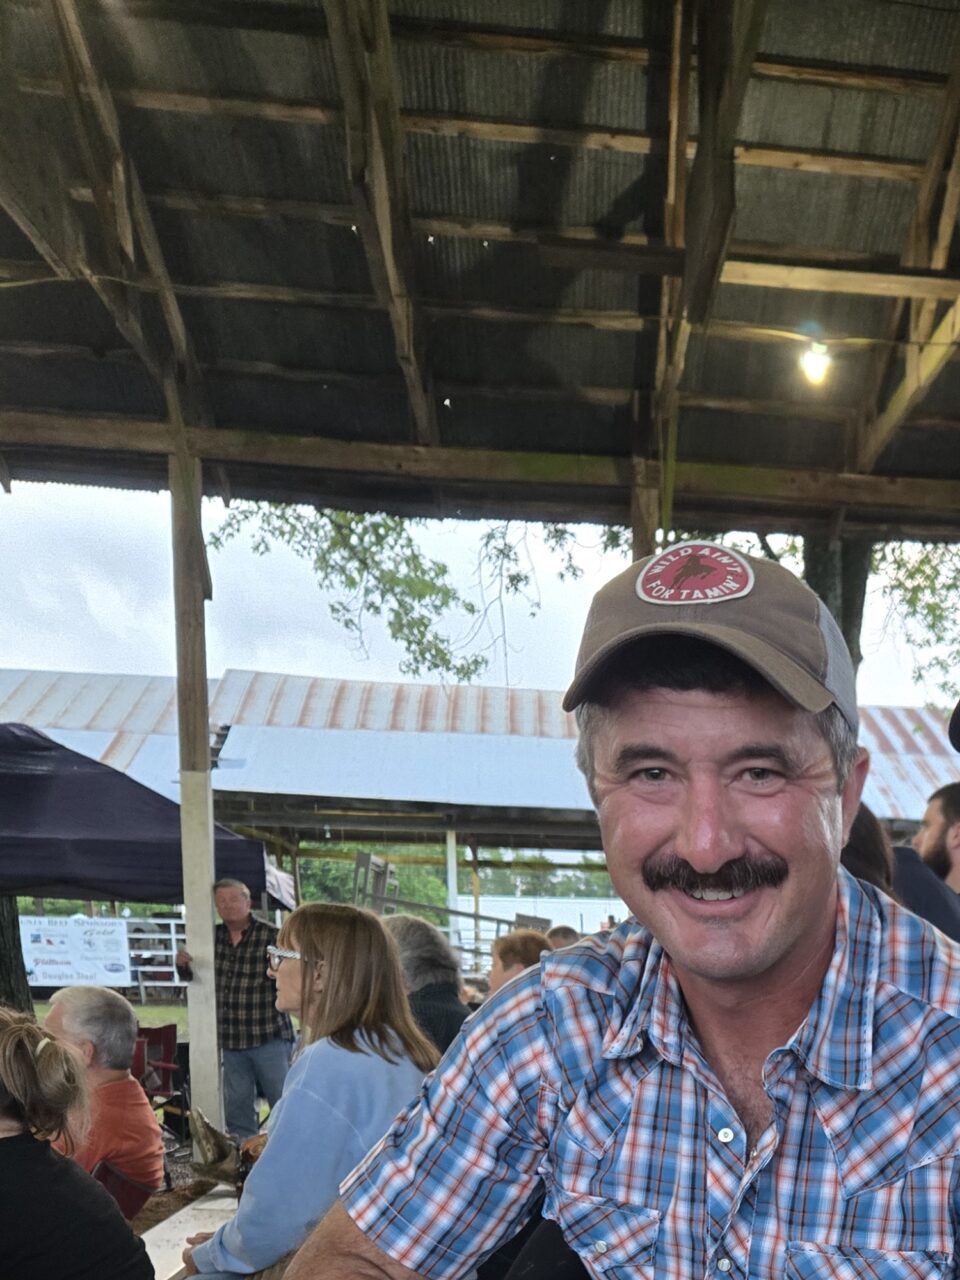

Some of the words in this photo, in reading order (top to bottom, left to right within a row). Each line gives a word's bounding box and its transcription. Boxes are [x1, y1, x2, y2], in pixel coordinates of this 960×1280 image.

[646, 547, 693, 577] WILD
[698, 547, 743, 574] AIN'T
[646, 580, 675, 599] FOR
[679, 575, 740, 599] TAMIN'
